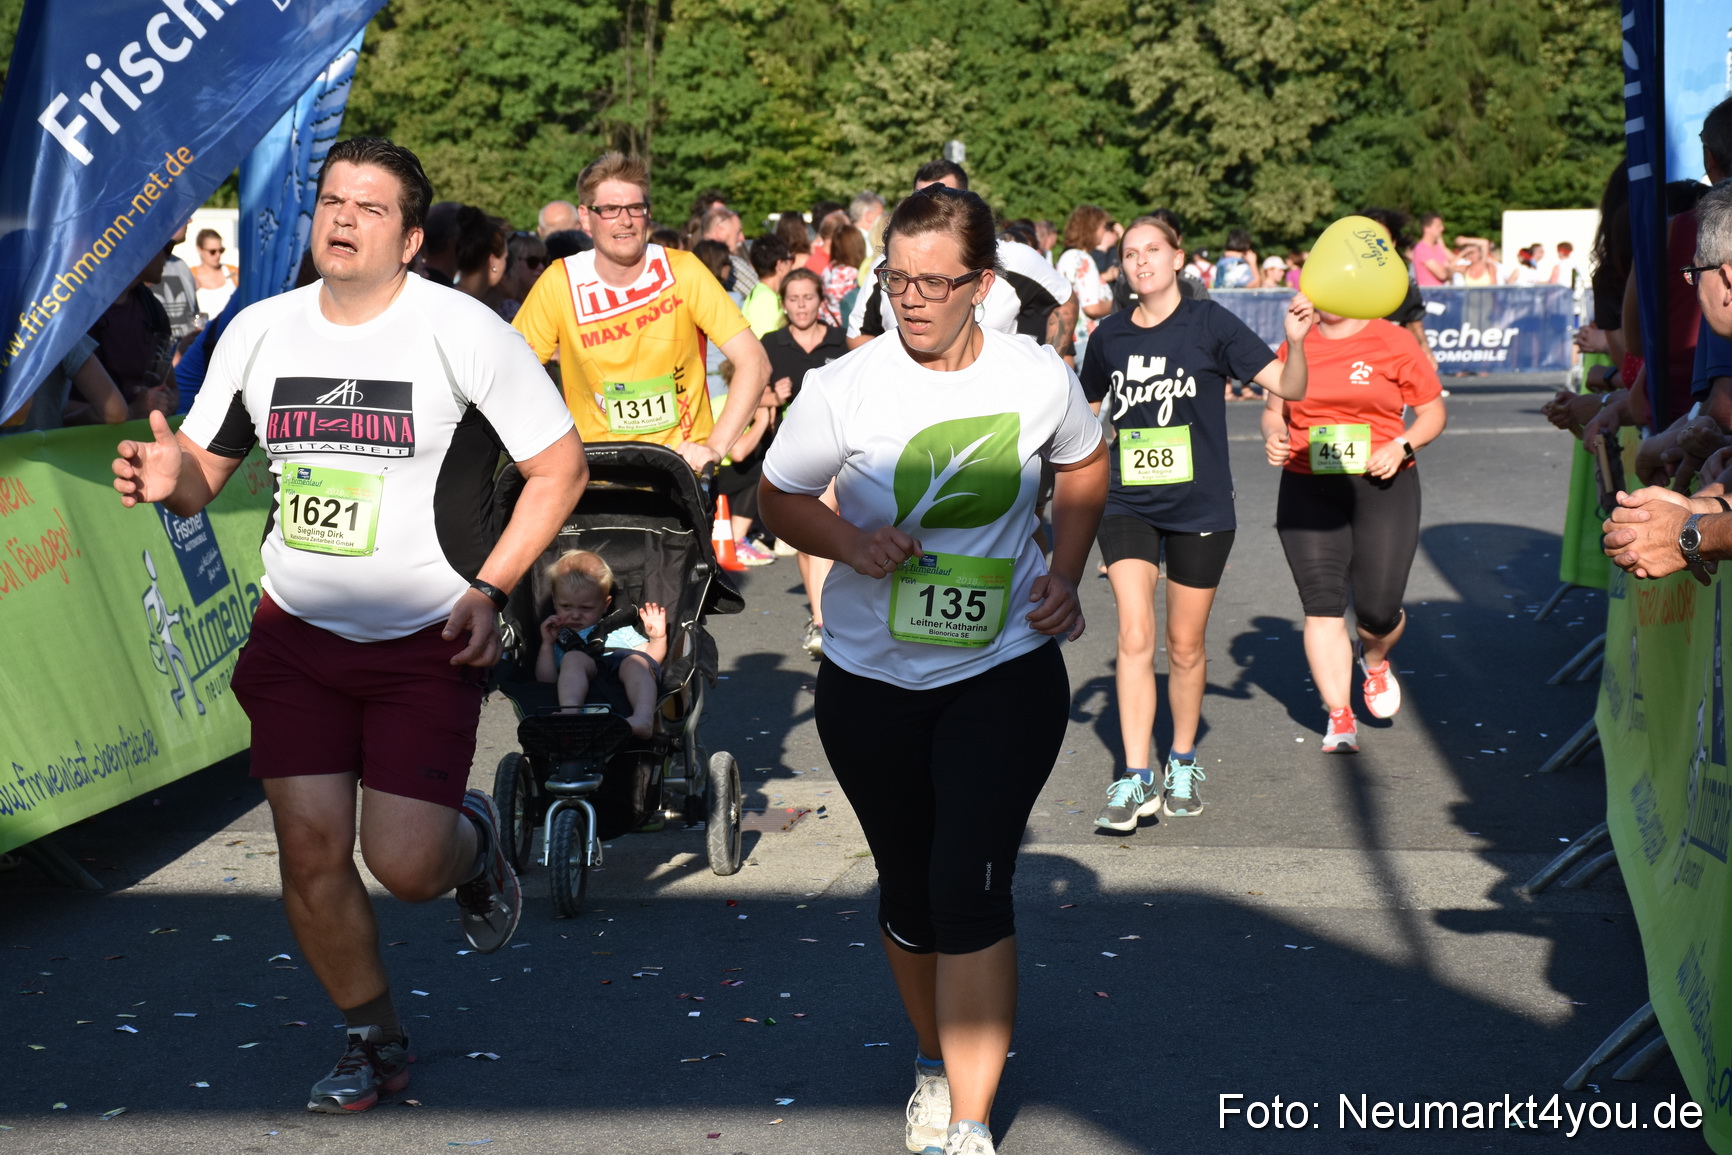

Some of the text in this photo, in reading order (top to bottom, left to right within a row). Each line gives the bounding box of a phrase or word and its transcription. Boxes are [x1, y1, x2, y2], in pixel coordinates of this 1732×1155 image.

[38, 0, 237, 166] Frisch
[1353, 227, 1386, 266] Burgis
[580, 322, 631, 349] MAX
[1424, 322, 1520, 348] scher
[1433, 349, 1508, 363] OMOBILE
[1349, 361, 1373, 380] 25
[613, 395, 666, 419] 1311
[1111, 367, 1197, 427] Burgis
[272, 443, 407, 456] ZEITARBEIT
[1133, 448, 1174, 469] 268
[1319, 442, 1356, 460] 454
[289, 494, 359, 531] 1621
[297, 526, 344, 539] Siegling Dirk
[310, 536, 335, 545] Zeitarbeit
[910, 563, 952, 577] firmenlauf
[955, 576, 978, 586] 2018
[919, 584, 987, 622] 135
[178, 568, 260, 671] firmenla
[910, 617, 988, 632] Leitner Katharina
[928, 629, 959, 639] Bionorica
[960, 631, 970, 639] SE
